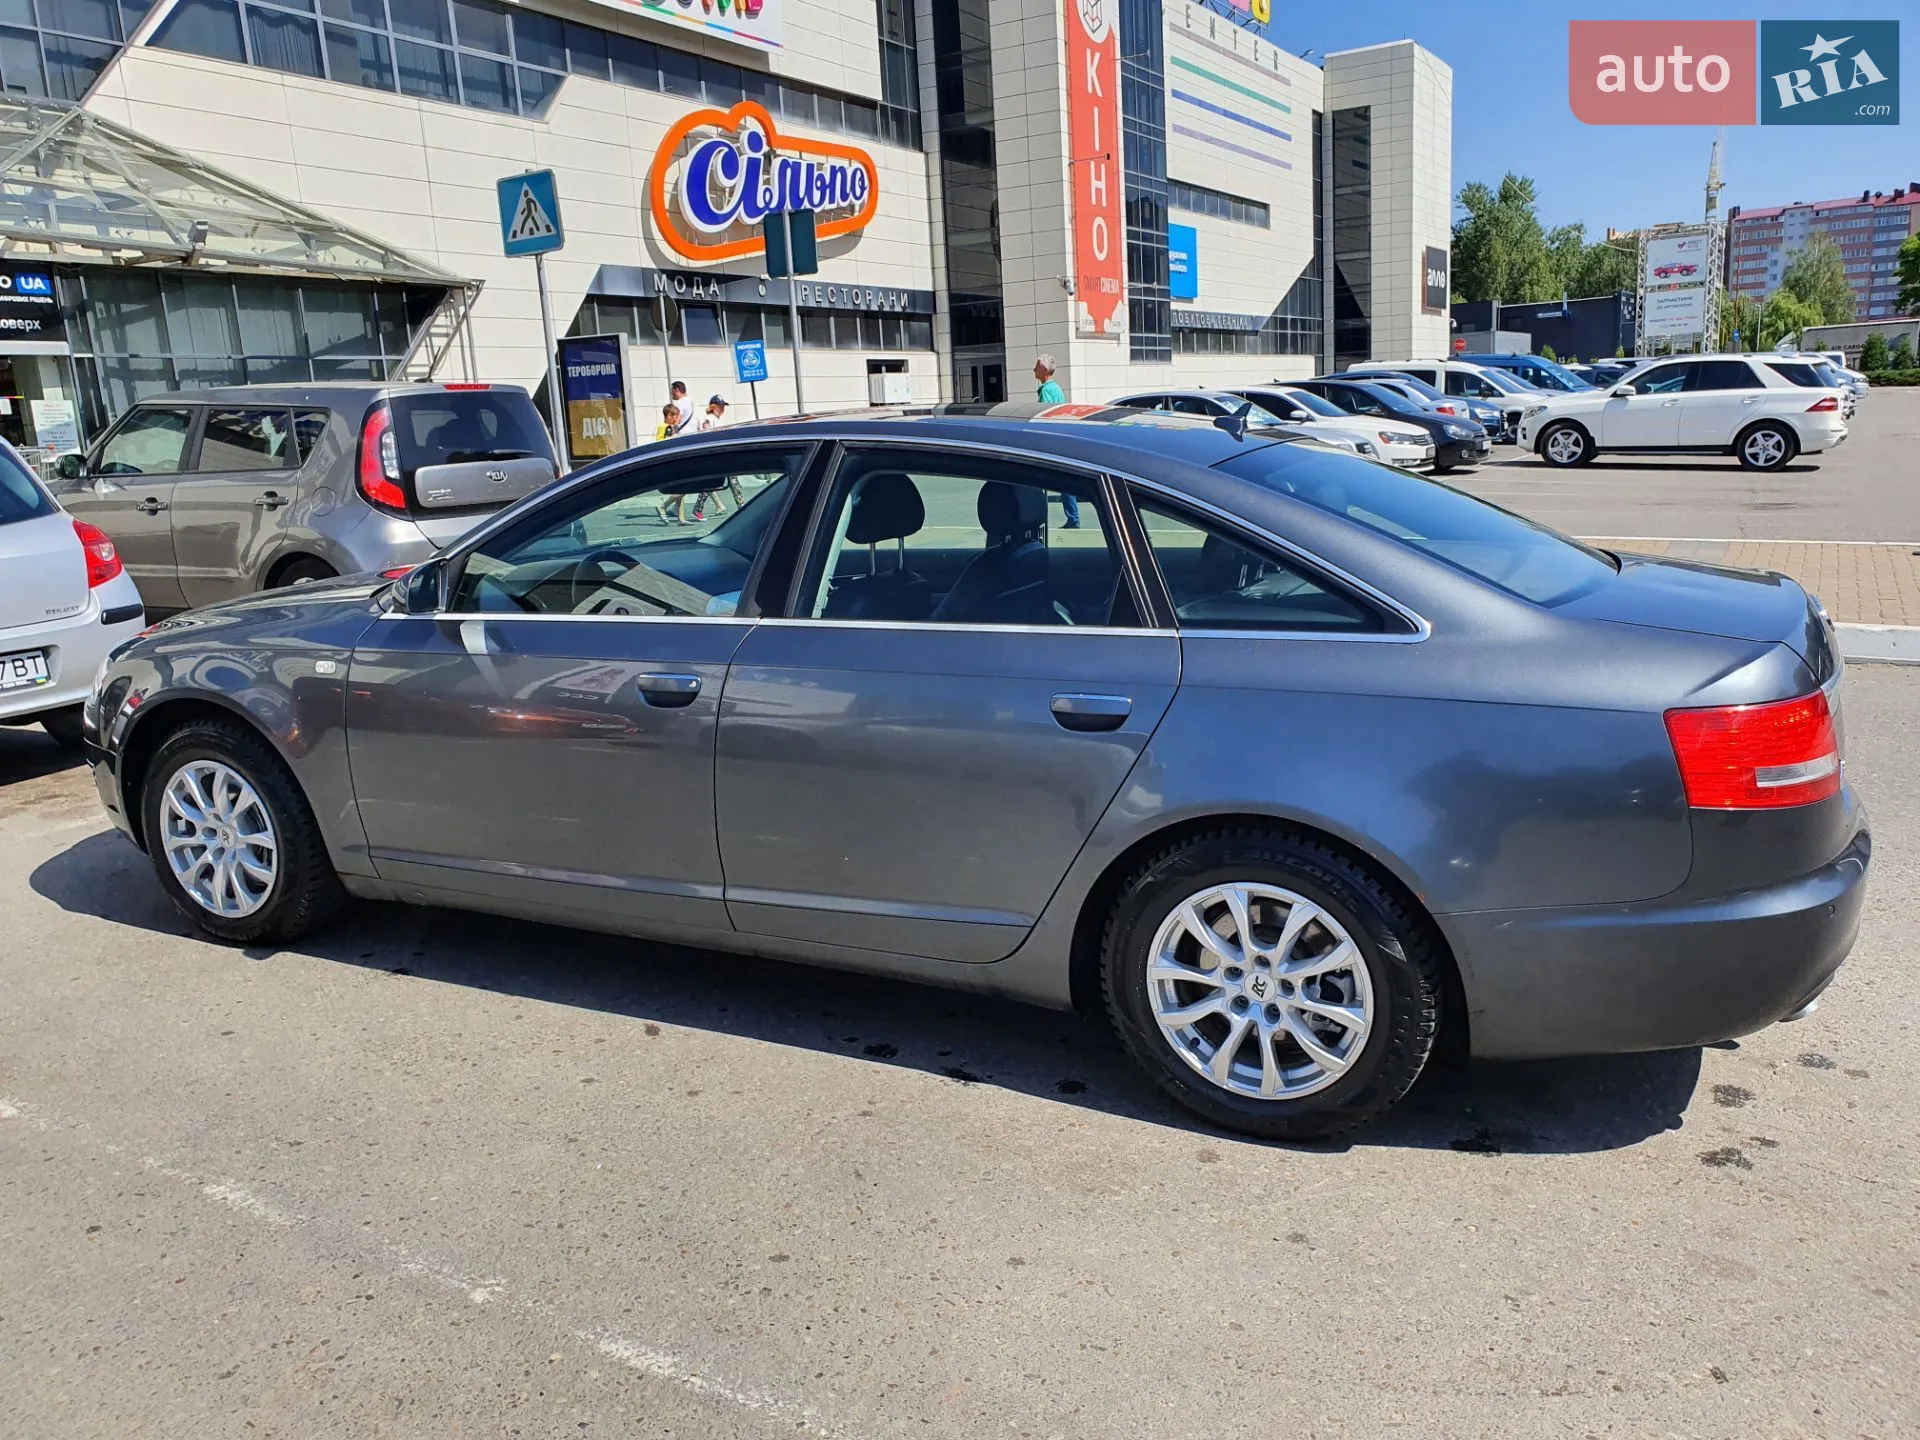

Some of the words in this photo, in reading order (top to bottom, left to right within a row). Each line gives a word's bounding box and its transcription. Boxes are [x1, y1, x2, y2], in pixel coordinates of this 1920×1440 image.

[1162, 4, 1279, 71] ENTER
[1086, 47, 1109, 262] КІНО
[681, 129, 870, 232] Сільпо
[20, 276, 47, 290] UA
[653, 273, 720, 299] МОДА
[801, 285, 909, 308] РЕСТОРАНИ
[0, 319, 42, 332] оверх
[567, 363, 617, 378] ТЕРОБОРОНА
[1251, 975, 1268, 998] RC
